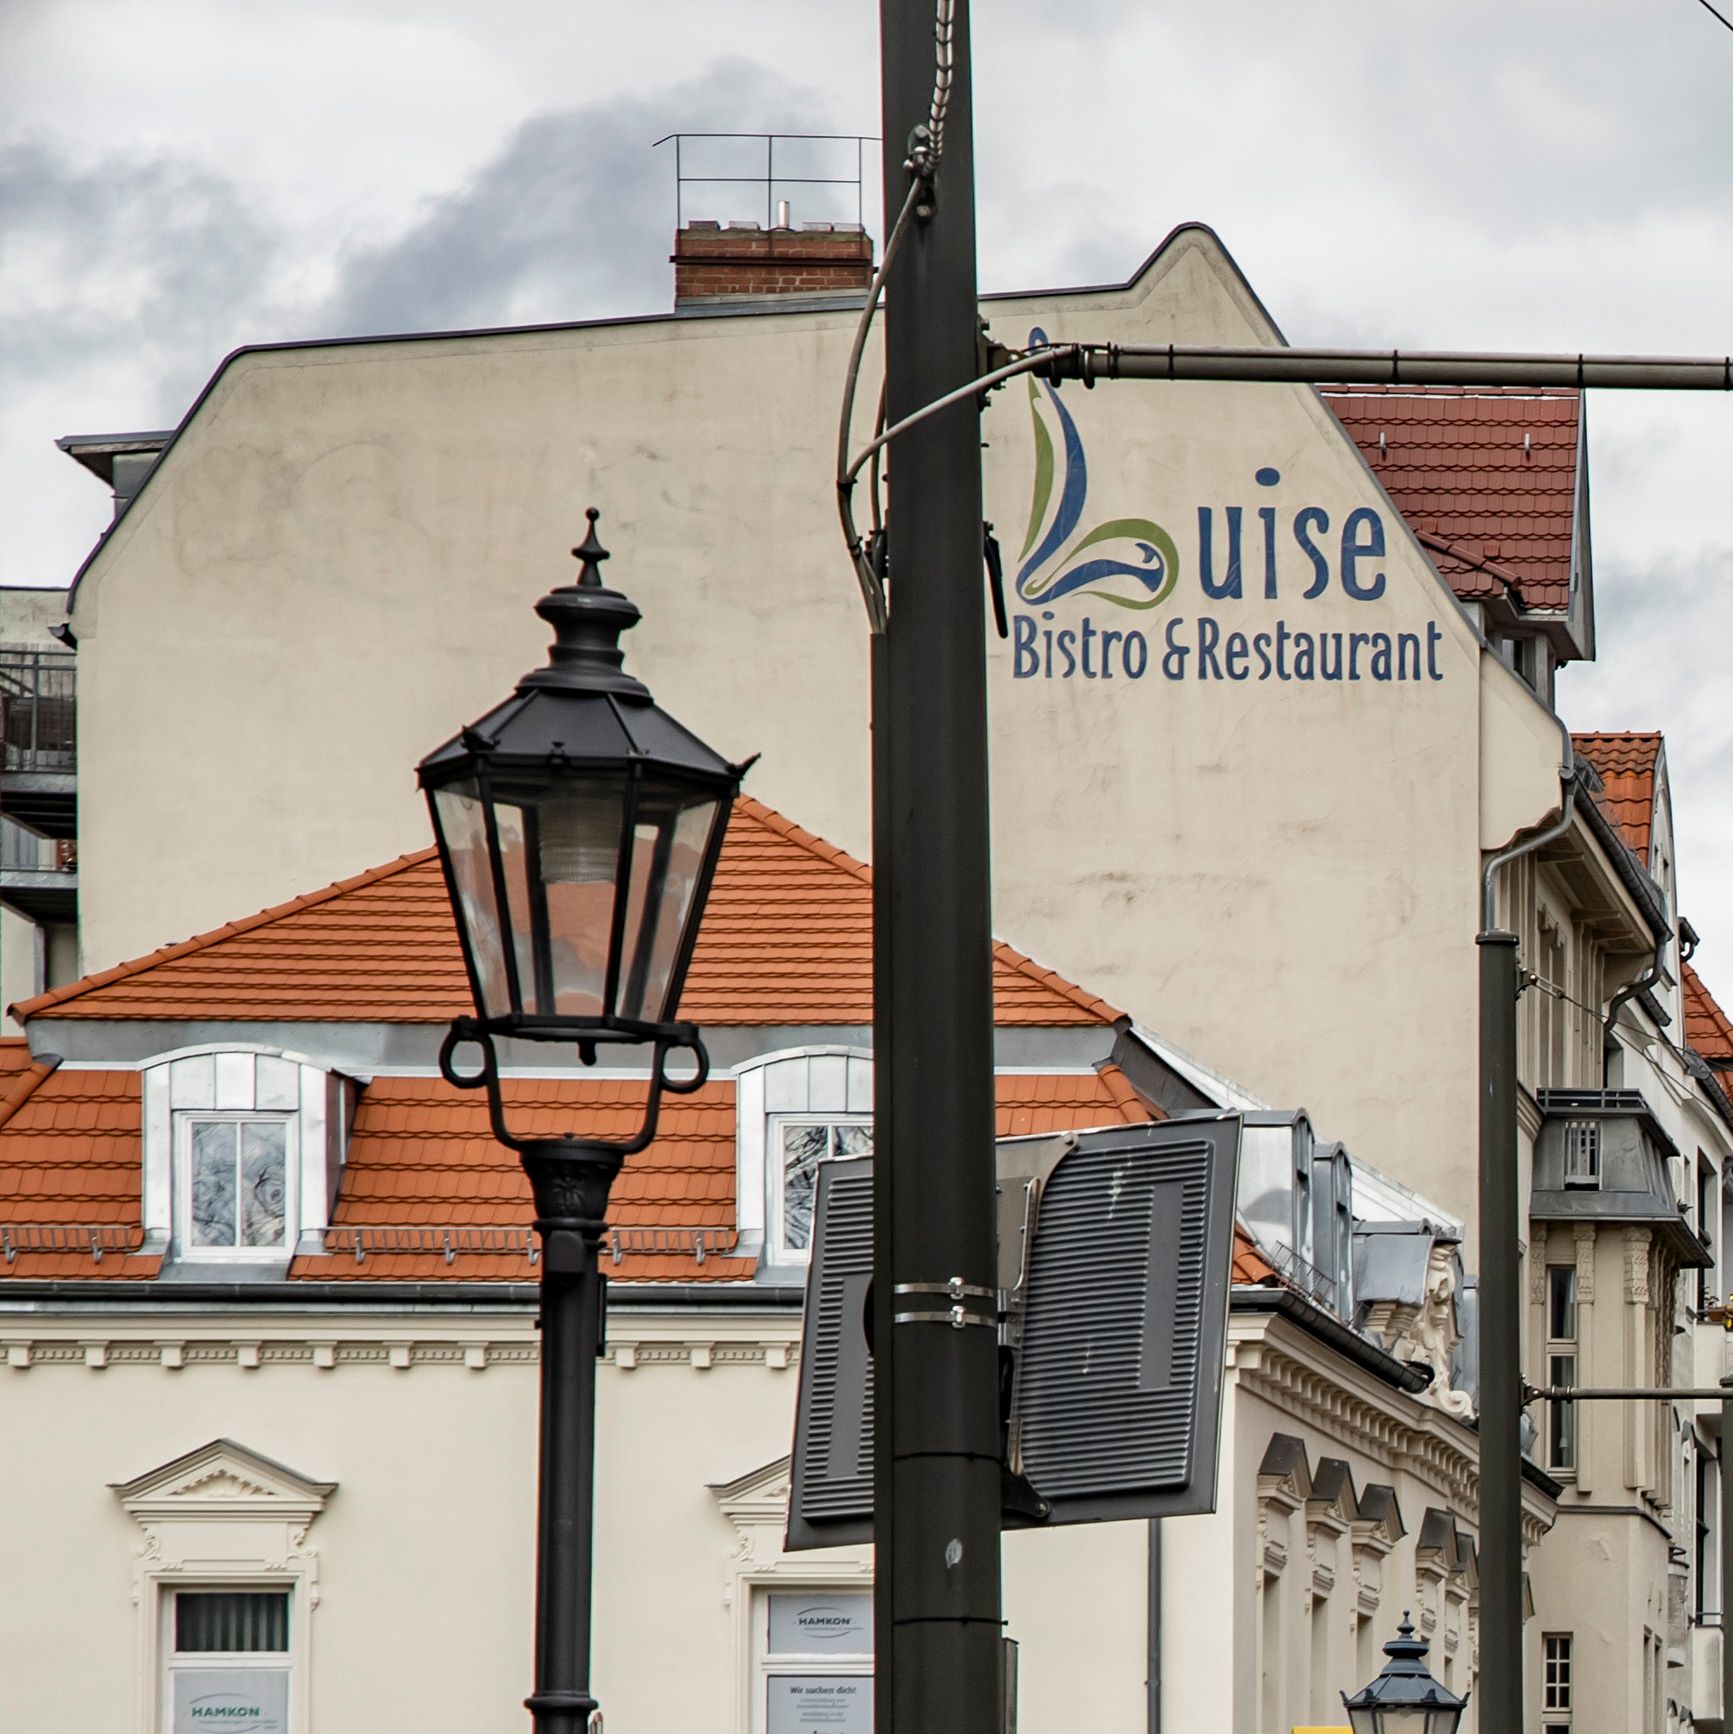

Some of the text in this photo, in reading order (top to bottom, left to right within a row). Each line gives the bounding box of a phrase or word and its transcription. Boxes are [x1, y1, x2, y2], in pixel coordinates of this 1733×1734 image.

[1012, 611, 1147, 681] Bistro
[1197, 616, 1444, 682] Restaurant
[191, 1706, 261, 1718] HAMKON
